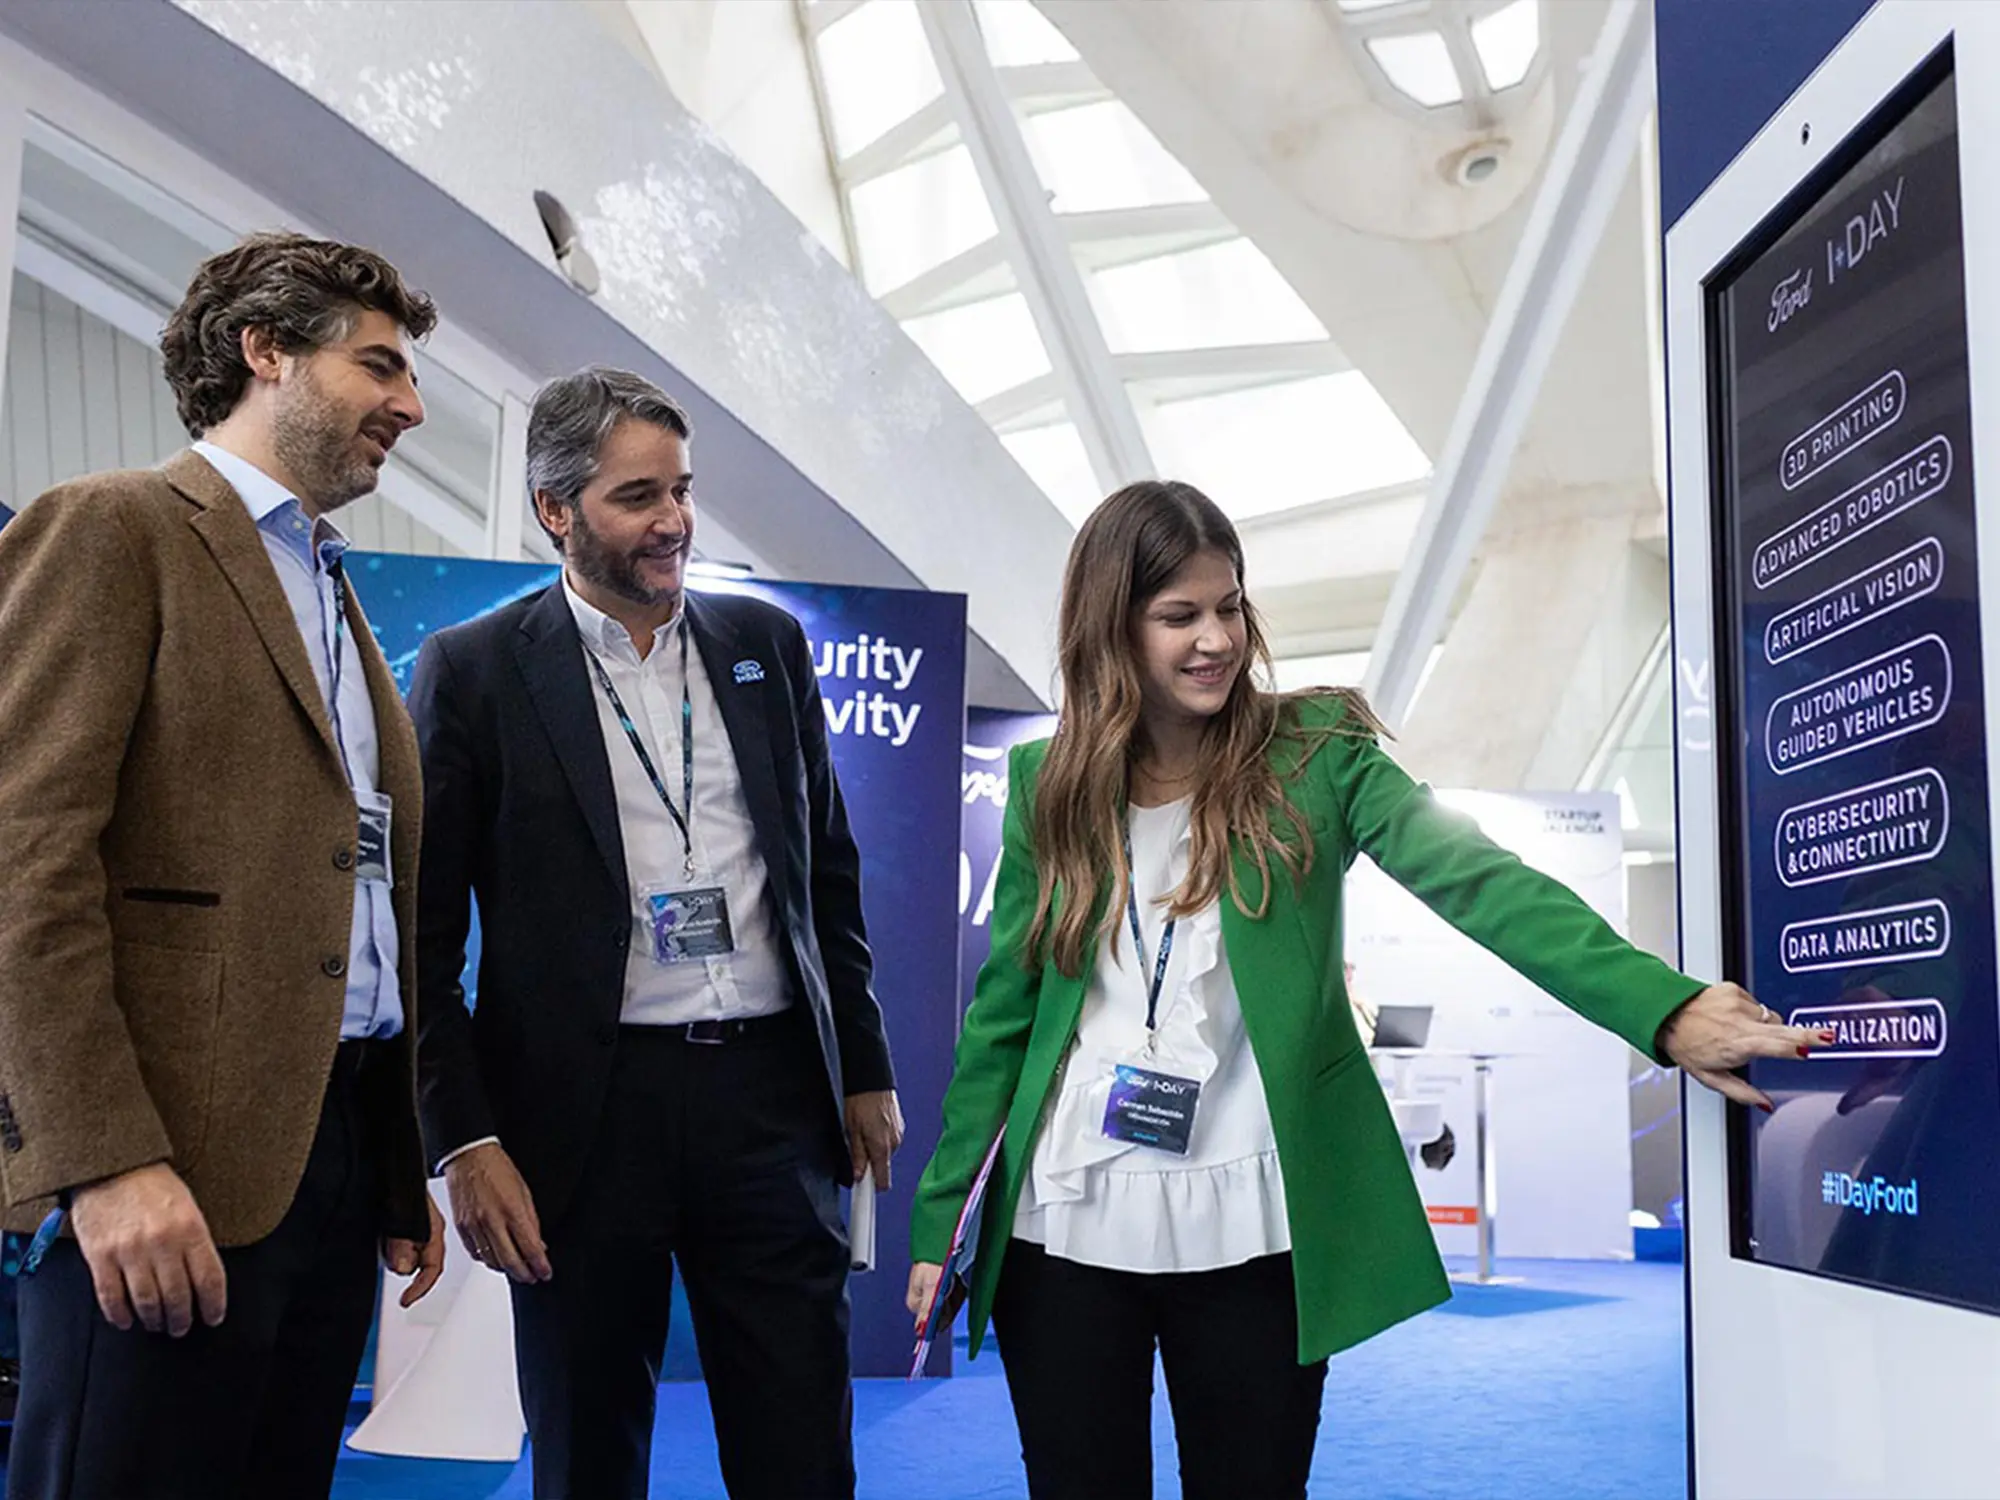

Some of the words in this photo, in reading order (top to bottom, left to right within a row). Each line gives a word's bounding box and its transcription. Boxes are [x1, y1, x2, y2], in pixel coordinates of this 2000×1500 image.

[1767, 268, 1813, 333] Ford
[1786, 449, 1807, 478] 3D
[1812, 388, 1895, 463] PRINTING
[1758, 513, 1842, 578] ADVANCED
[1847, 452, 1941, 527] ROBOTICS
[1771, 592, 1861, 653] ARTIFICIAL
[1865, 554, 1933, 606] VISION
[1777, 722, 1838, 762] GUIDED
[1842, 685, 1934, 738] VEHICLES
[1790, 659, 1914, 727] AUTONOMOUS
[1785, 784, 1930, 843] CYBERSECURITY
[1786, 819, 1931, 875] &CONNECTIVITY
[1788, 933, 1829, 960] DATA
[1834, 916, 1938, 954] ANALYTICS
[1822, 1171, 1919, 1216] #iDayFord
